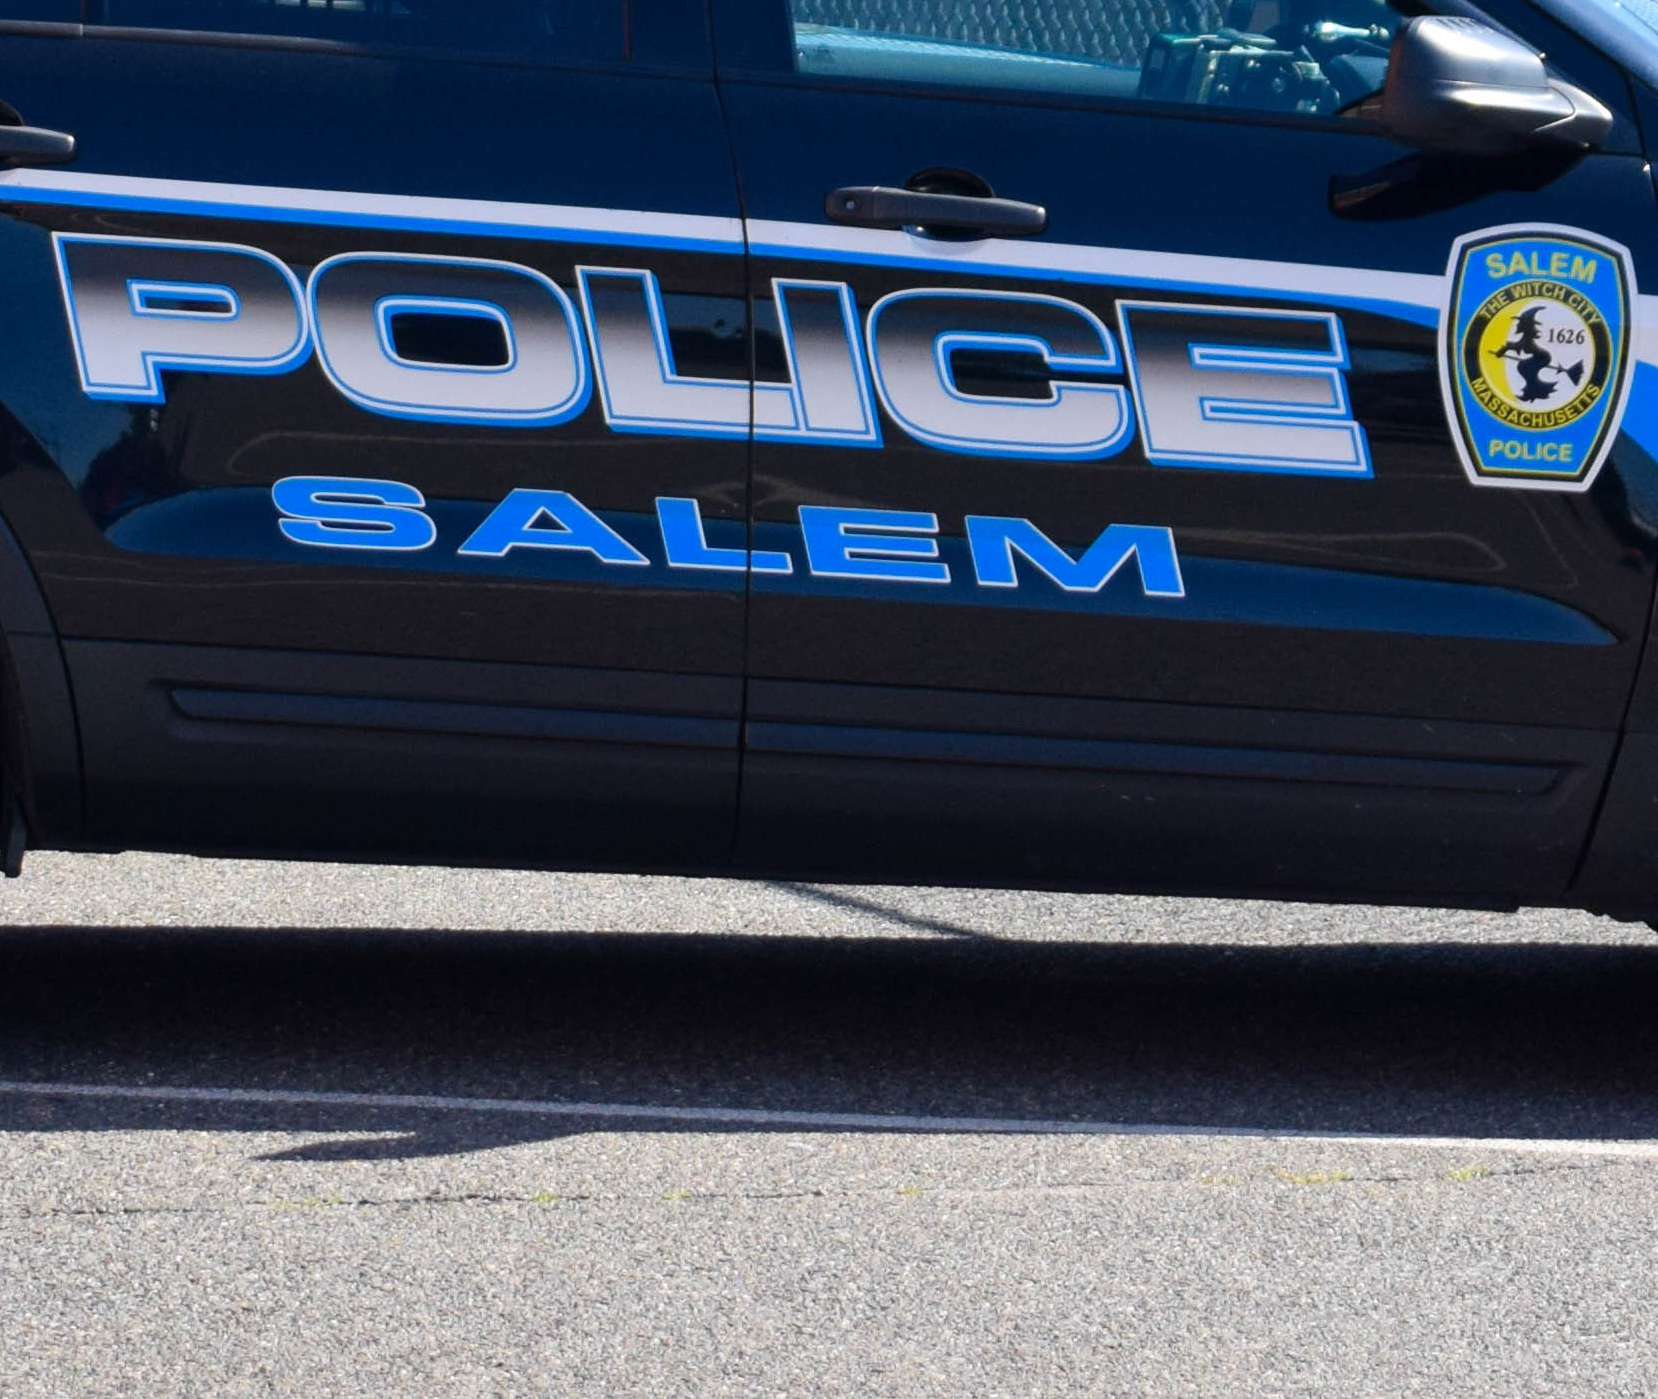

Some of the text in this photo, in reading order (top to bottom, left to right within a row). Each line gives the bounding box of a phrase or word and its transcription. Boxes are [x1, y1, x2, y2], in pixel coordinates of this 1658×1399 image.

[1486, 249, 1597, 283] SALEM
[1480, 281, 1602, 325] THE WITCH CITY
[51, 229, 1375, 479] POLICE
[1547, 327, 1585, 345] 1626
[1471, 376, 1601, 428] MASSACHUSETTS
[1489, 439, 1574, 462] POLICE
[270, 475, 1186, 598] SALEM
